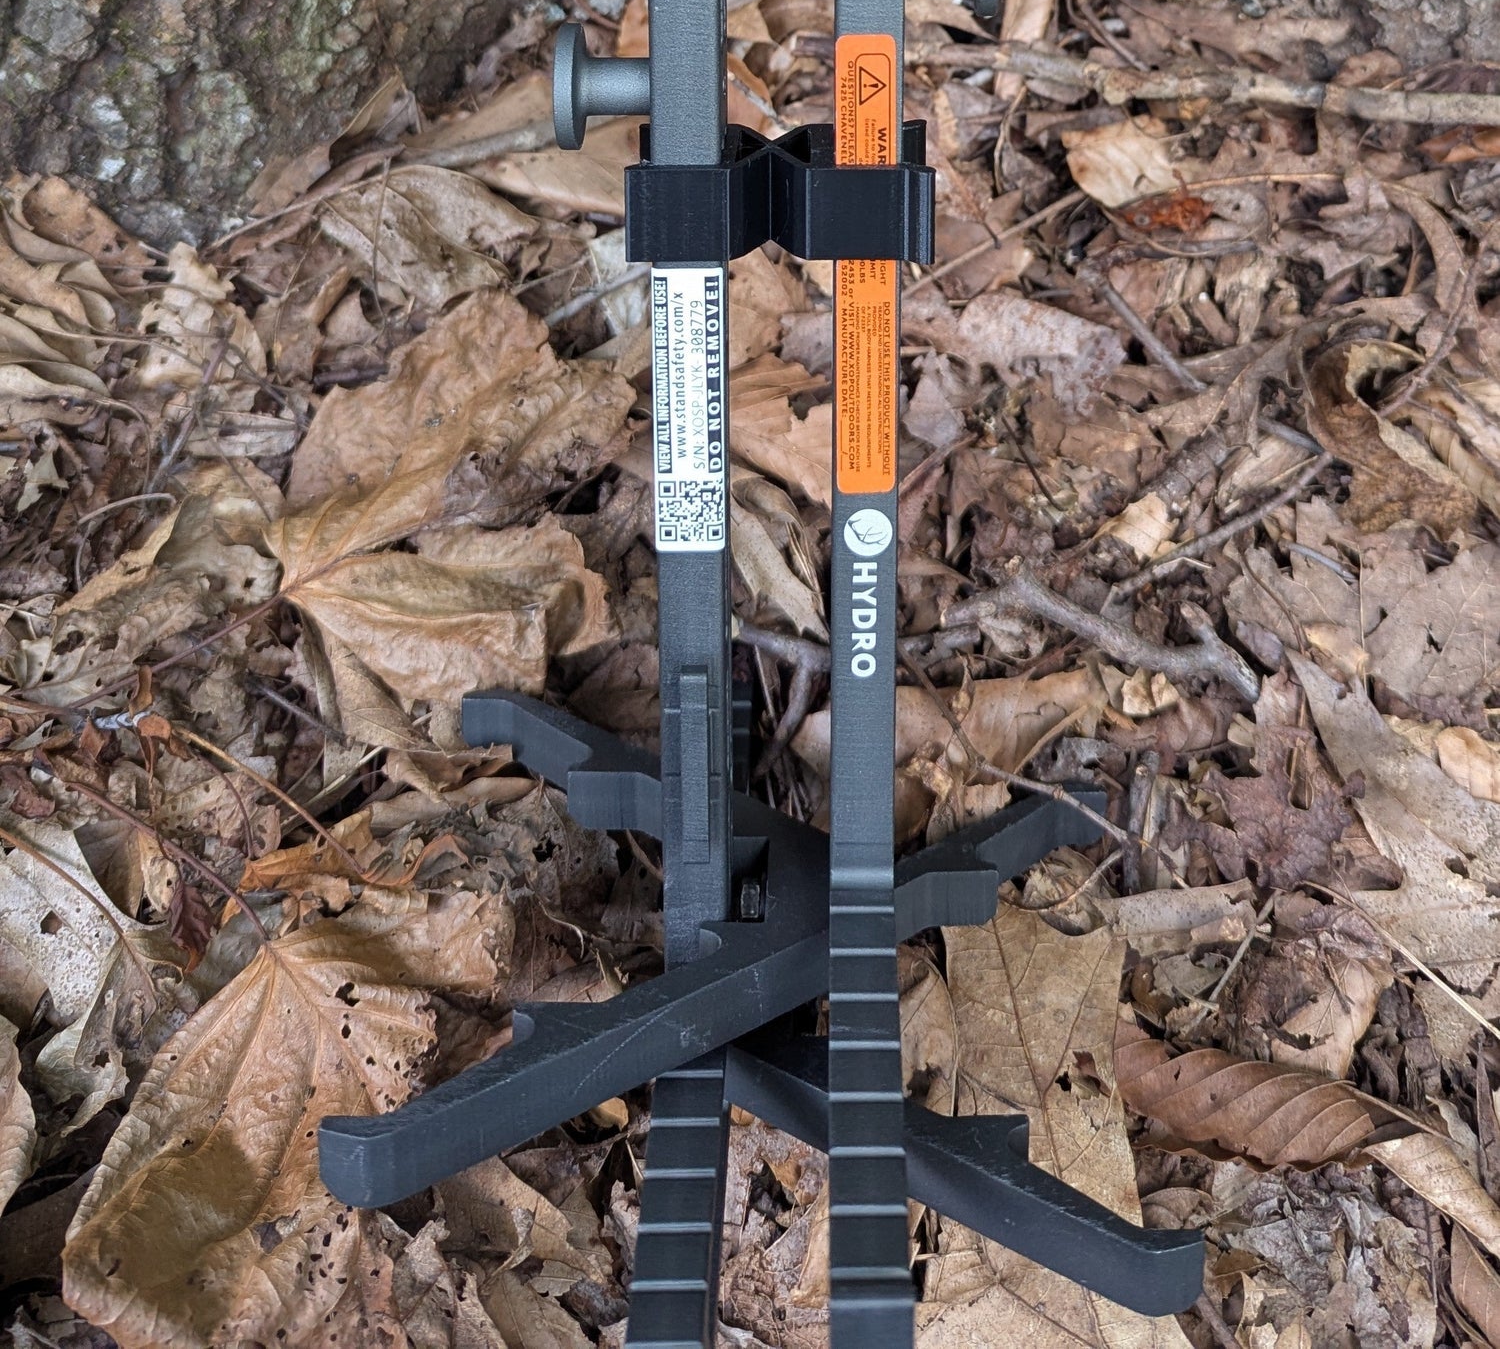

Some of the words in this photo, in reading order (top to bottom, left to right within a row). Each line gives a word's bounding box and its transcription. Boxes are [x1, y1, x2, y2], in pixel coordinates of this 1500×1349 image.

[878, 128, 887, 165] WAR
[655, 280, 666, 304] USE!
[849, 288, 853, 299] or
[861, 306, 865, 314] OF
[884, 302, 890, 315] DO
[656, 307, 668, 346] BEFORE
[690, 301, 703, 353] 308779
[707, 281, 720, 378] REMOVE!
[656, 349, 669, 420] INFORMATION
[671, 292, 687, 458] www.standsafety.com/x
[708, 389, 721, 430] NOT
[658, 423, 670, 441] ALL
[658, 443, 671, 471] VIEW
[693, 441, 705, 469] S/N:
[709, 441, 721, 469] DO
[851, 562, 877, 677] HYDRO
